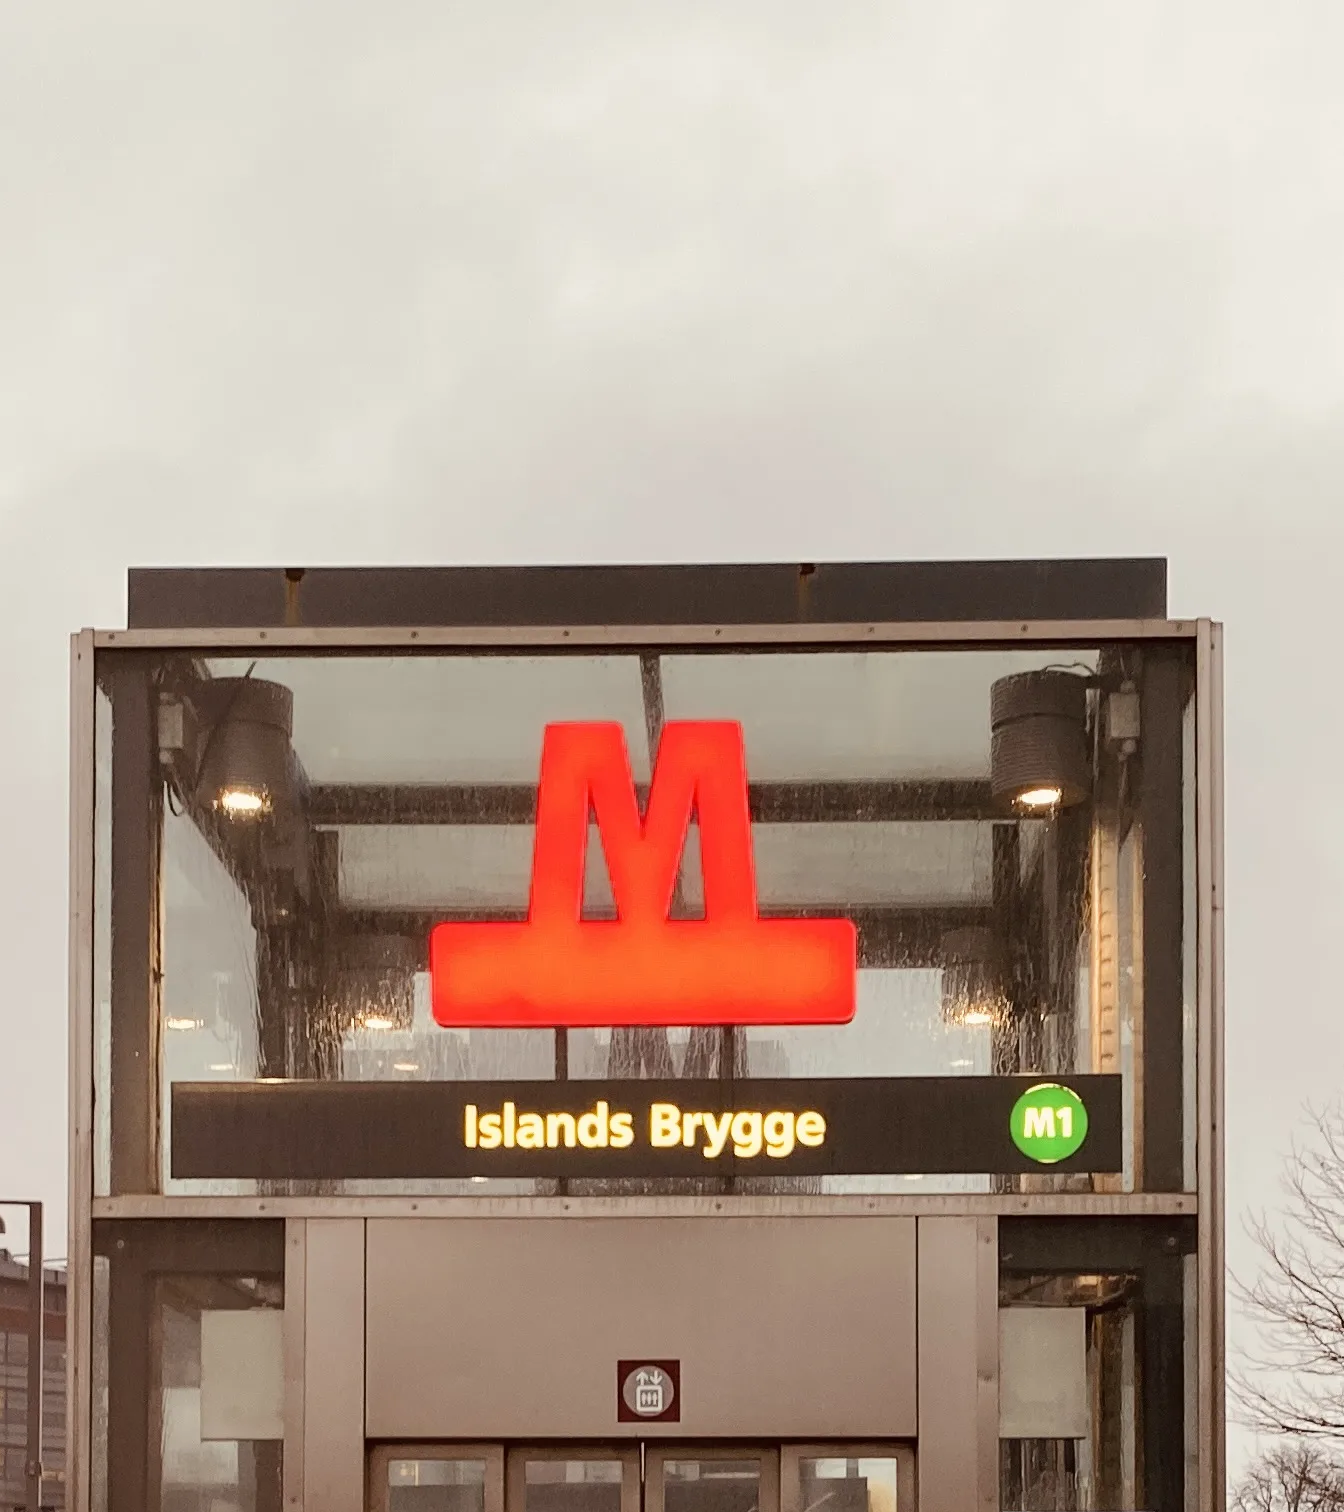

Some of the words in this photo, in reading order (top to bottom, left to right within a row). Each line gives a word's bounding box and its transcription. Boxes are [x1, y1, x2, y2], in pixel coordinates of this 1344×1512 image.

[464, 1101, 635, 1150] Islands
[649, 1102, 827, 1159] Brygge
[1023, 1106, 1073, 1139] M1
